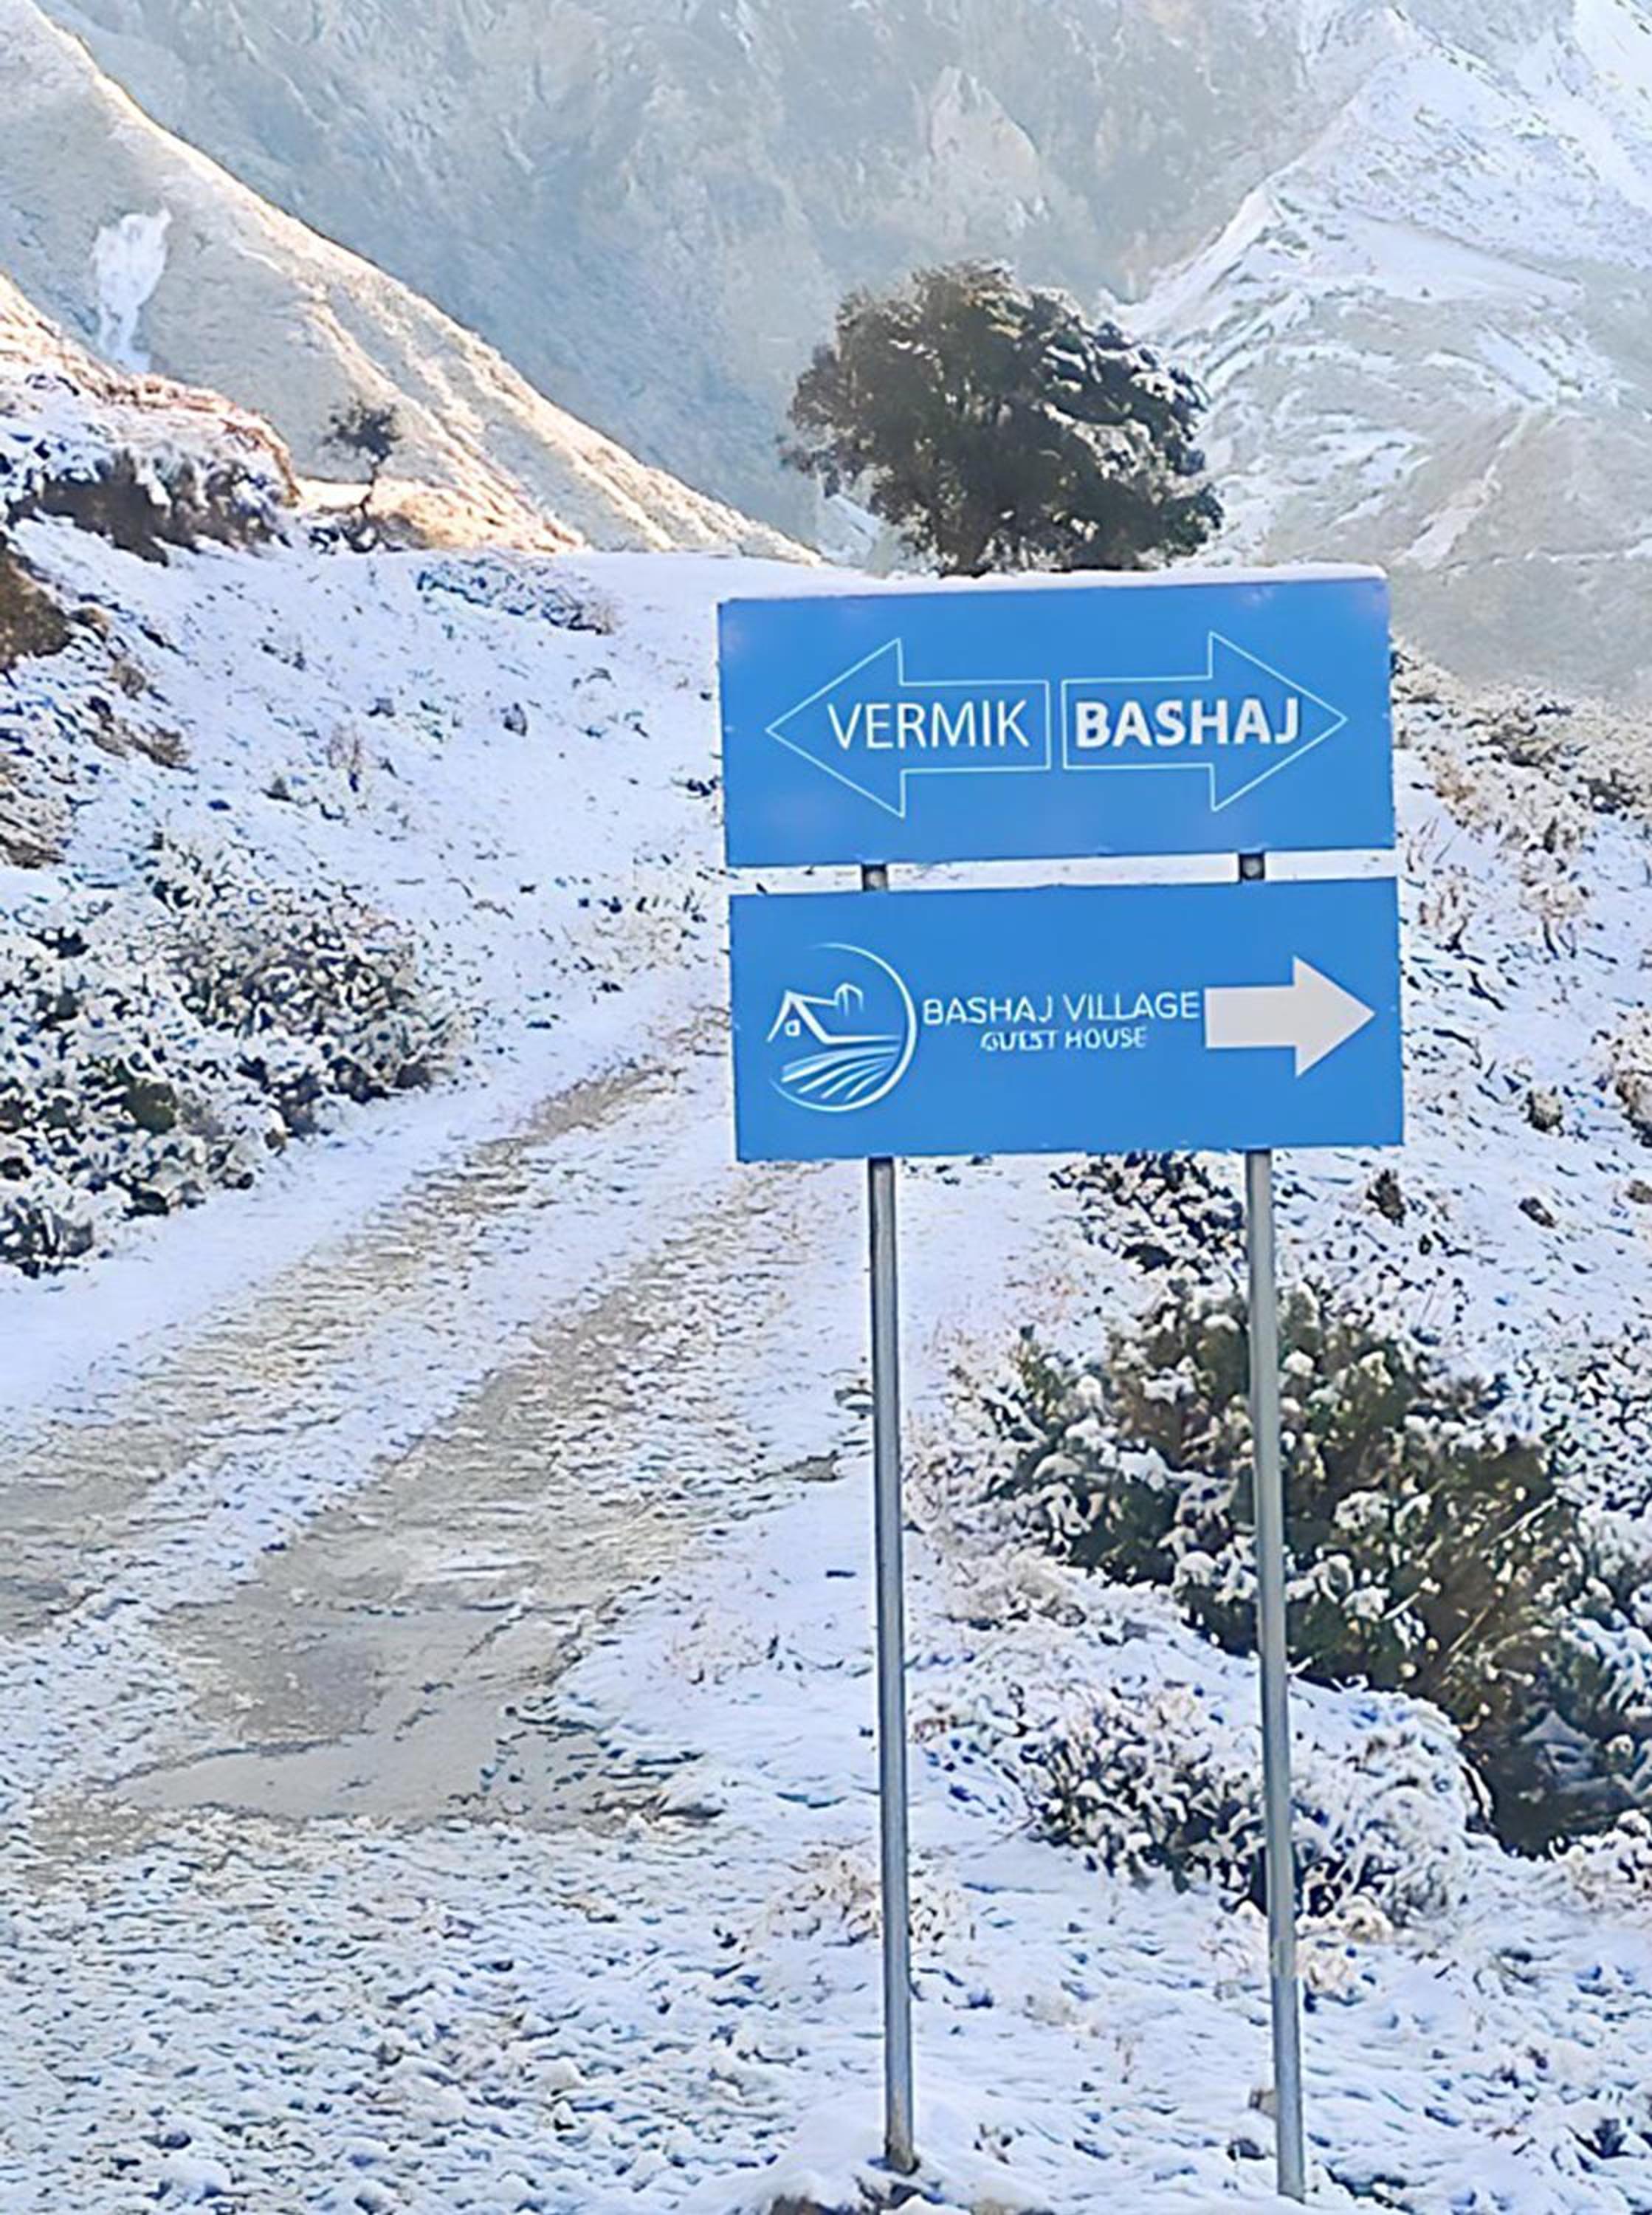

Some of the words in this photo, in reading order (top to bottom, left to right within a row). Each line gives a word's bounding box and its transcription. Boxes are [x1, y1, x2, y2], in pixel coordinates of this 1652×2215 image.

[827, 698, 1030, 750] VERMIK
[1074, 697, 1301, 749] BASHAJ
[922, 995, 1054, 1026] BASHAJ
[1061, 991, 1200, 1022] VILLAGE
[980, 1029, 1059, 1051] GUEST
[1064, 1026, 1148, 1050] HOUSE
